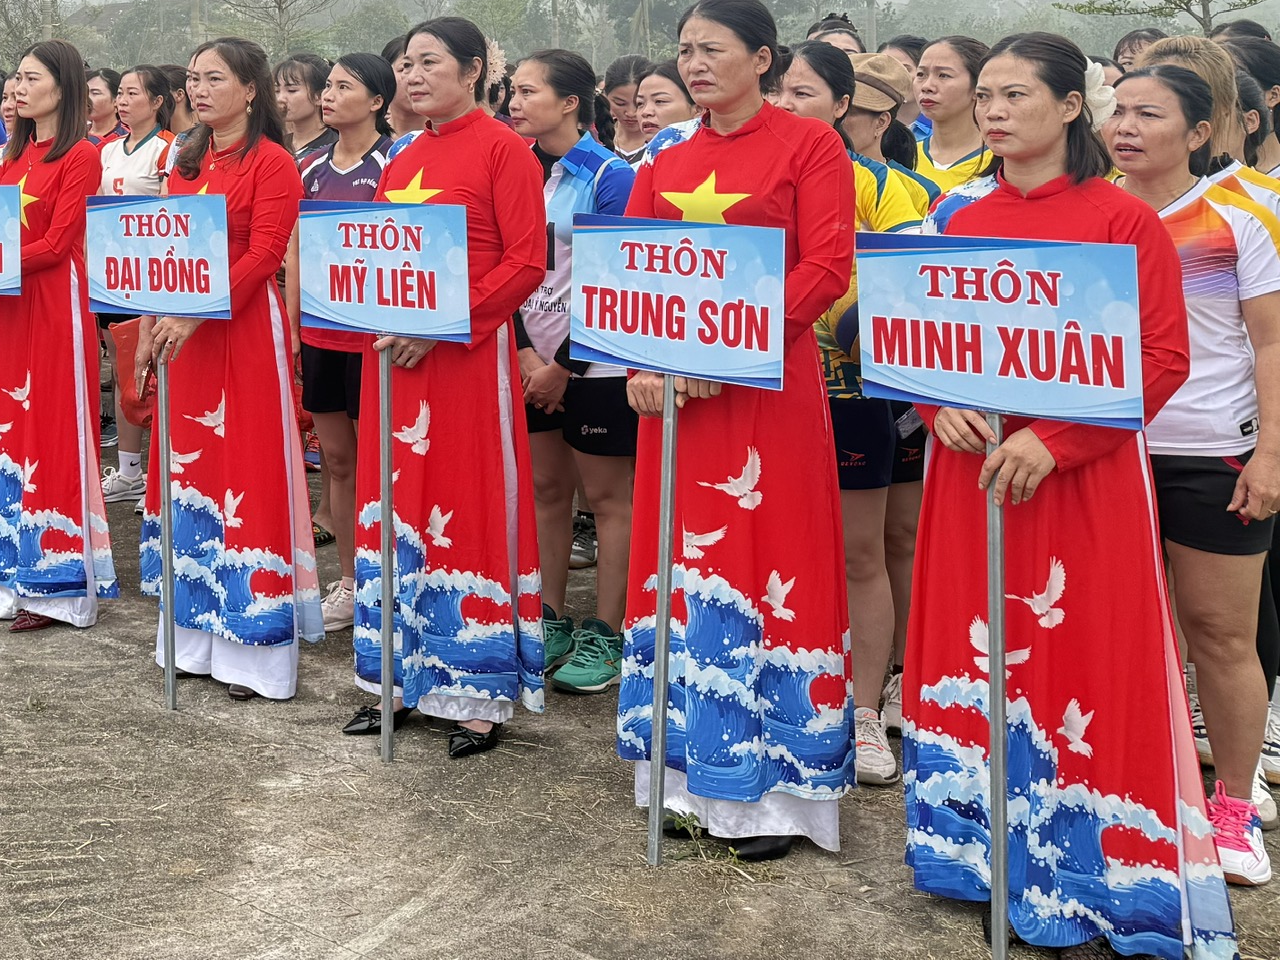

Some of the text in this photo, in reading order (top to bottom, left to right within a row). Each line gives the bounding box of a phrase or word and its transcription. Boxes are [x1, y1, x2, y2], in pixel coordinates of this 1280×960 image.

[120, 207, 191, 238] THÔN
[337, 217, 423, 253] THÔN
[105, 245, 211, 300] ĐẠI ĐỒNG
[619, 237, 729, 280] THÔN
[919, 258, 1063, 307] THÔN
[329, 257, 438, 311] MỸ LIÊN
[581, 285, 770, 353] TRUNG SƠN
[871, 316, 1126, 389] MINH XUÂN
[589, 426, 608, 435] yeka
